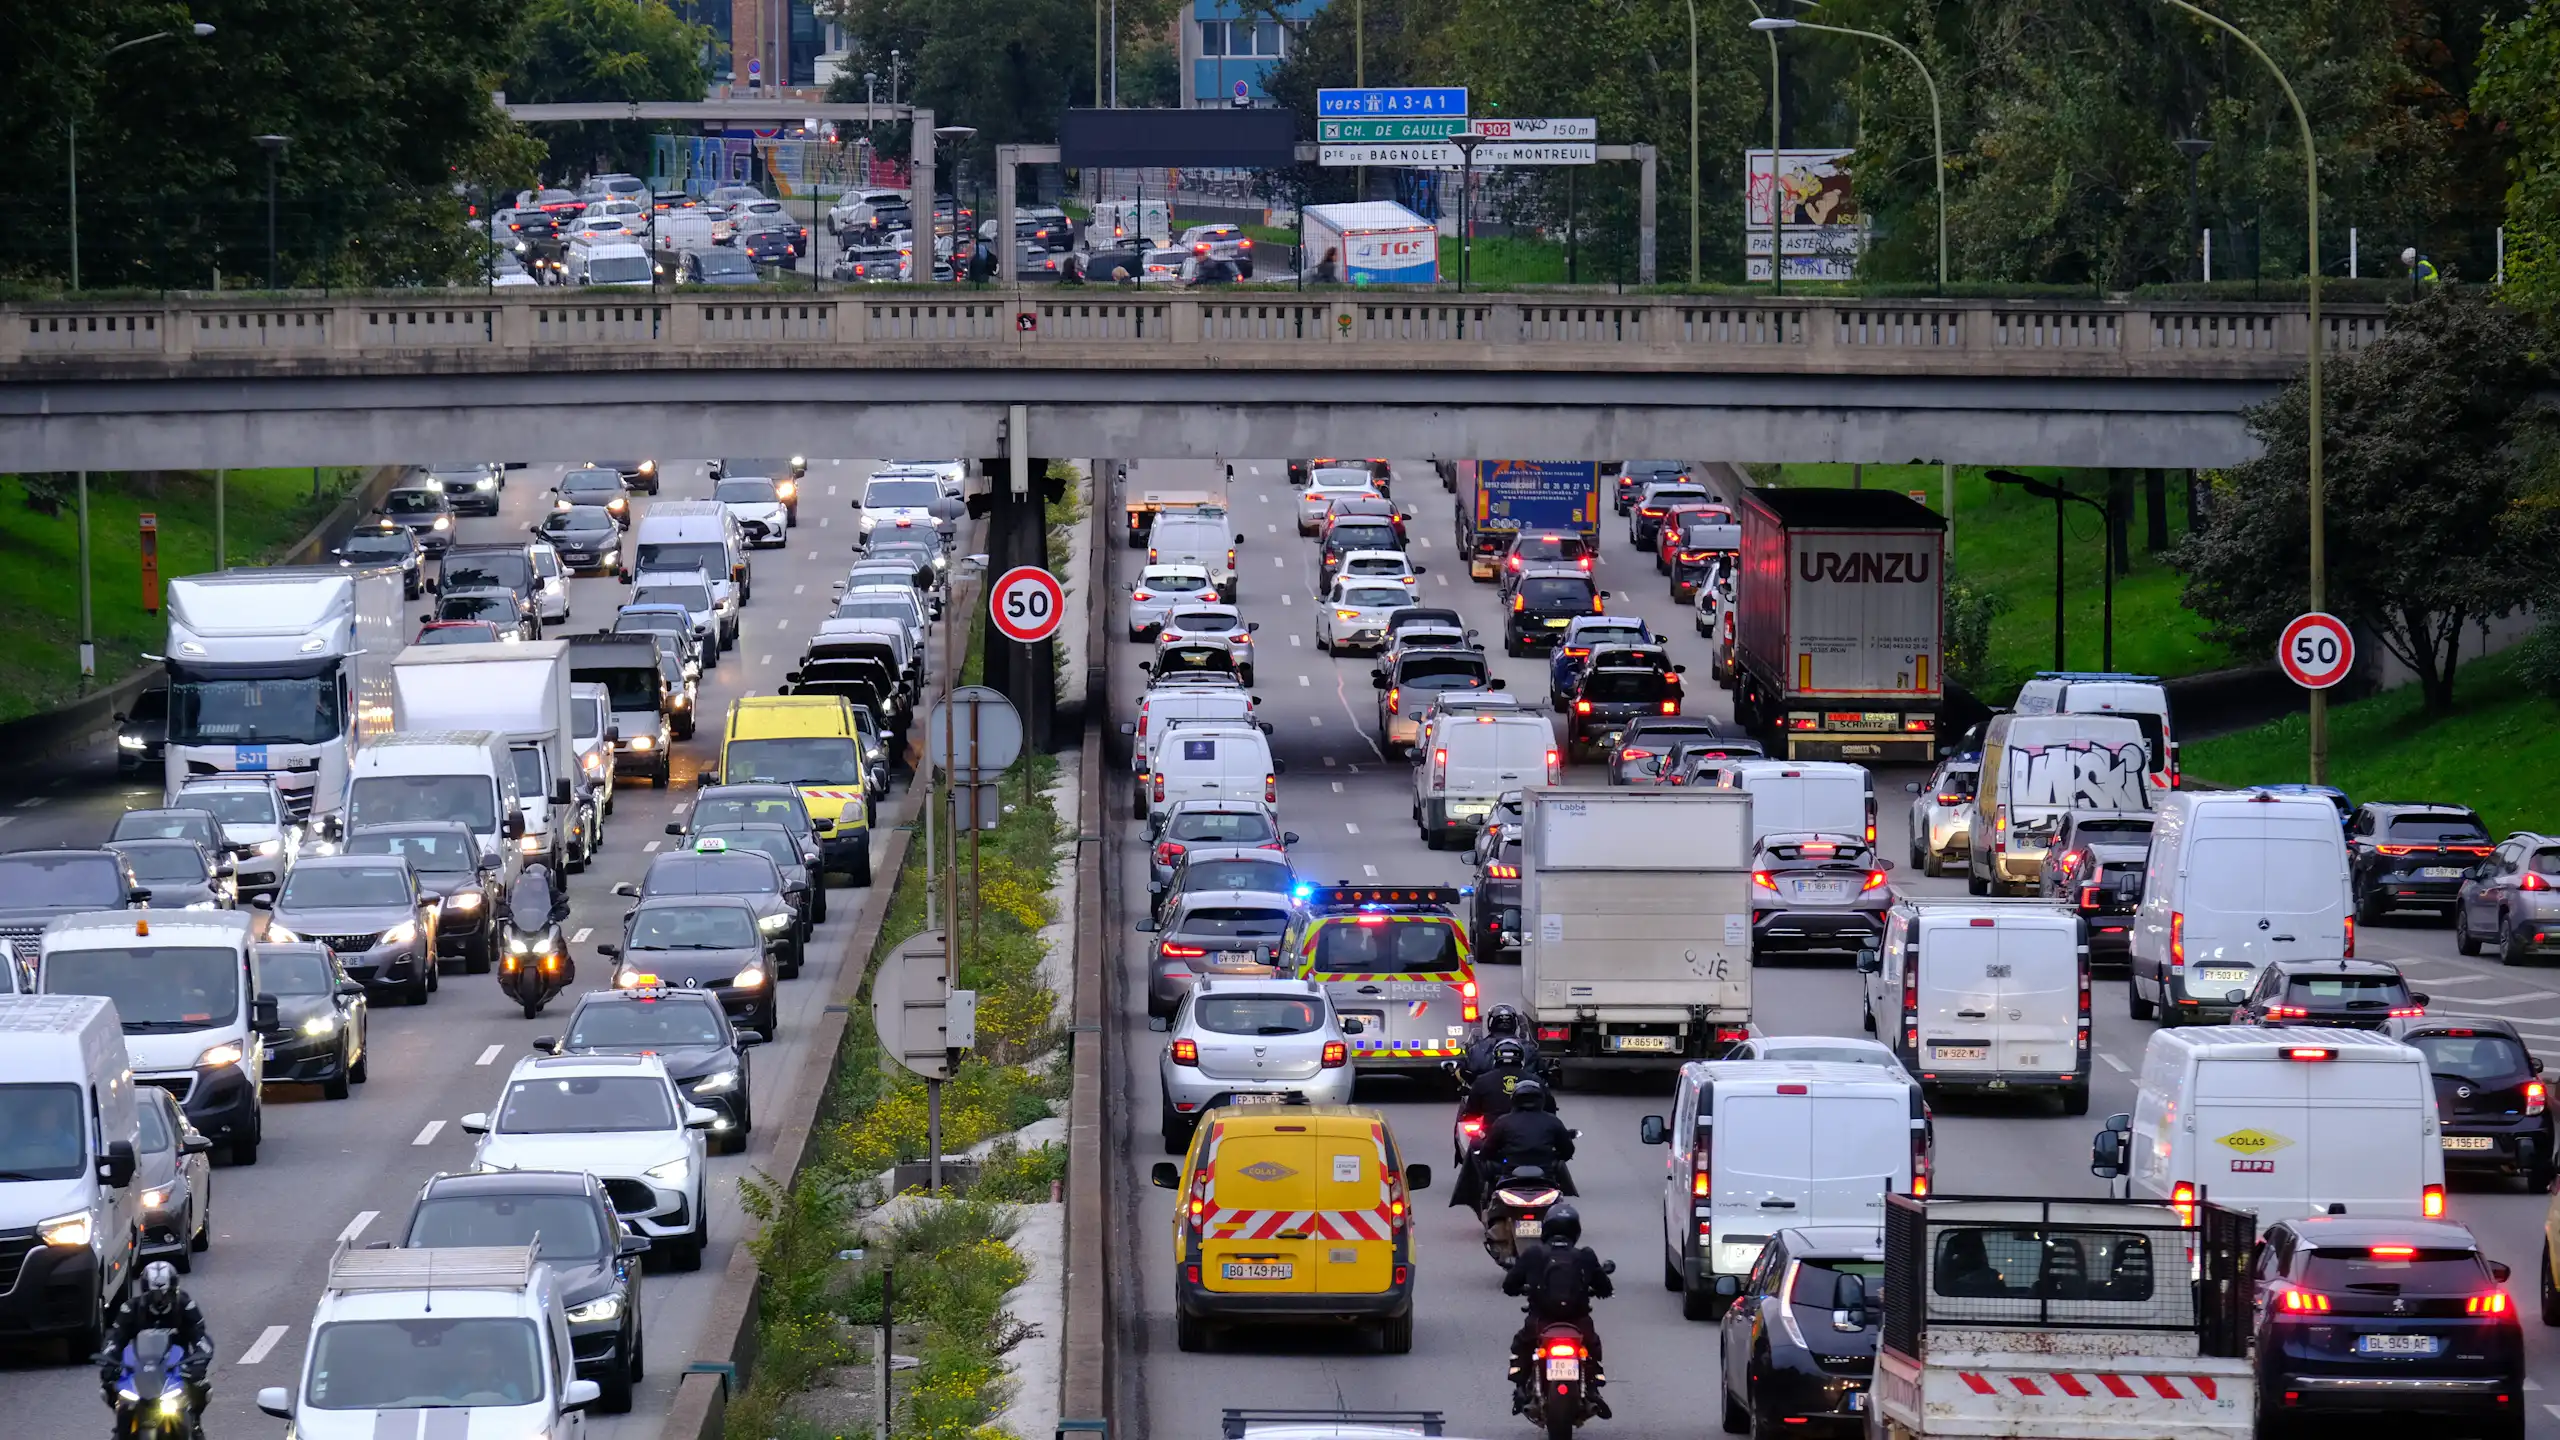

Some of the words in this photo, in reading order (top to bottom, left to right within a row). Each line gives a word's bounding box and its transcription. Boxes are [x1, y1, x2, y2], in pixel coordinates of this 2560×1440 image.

[1326, 99, 1361, 110] vers
[1344, 125, 1365, 136] CH.
[1375, 125, 1393, 136] DE
[1402, 124, 1454, 136] GAULLE
[1370, 149, 1448, 160] BAGNOLET
[1497, 151, 1508, 159] DE
[1513, 148, 1591, 159] MONTREUIL
[1800, 551, 1929, 583] URANZU
[1008, 590, 1048, 617] 50
[2297, 637, 2337, 664] 50
[237, 752, 268, 764] SJT
[1391, 983, 1441, 992] POLICE
[2229, 1137, 2266, 1146] COLAS
[1248, 1167, 1277, 1175] COLAS
[1229, 1265, 1285, 1277] BQ-149-PH
[2369, 1337, 2428, 1350] GL-949-AF
